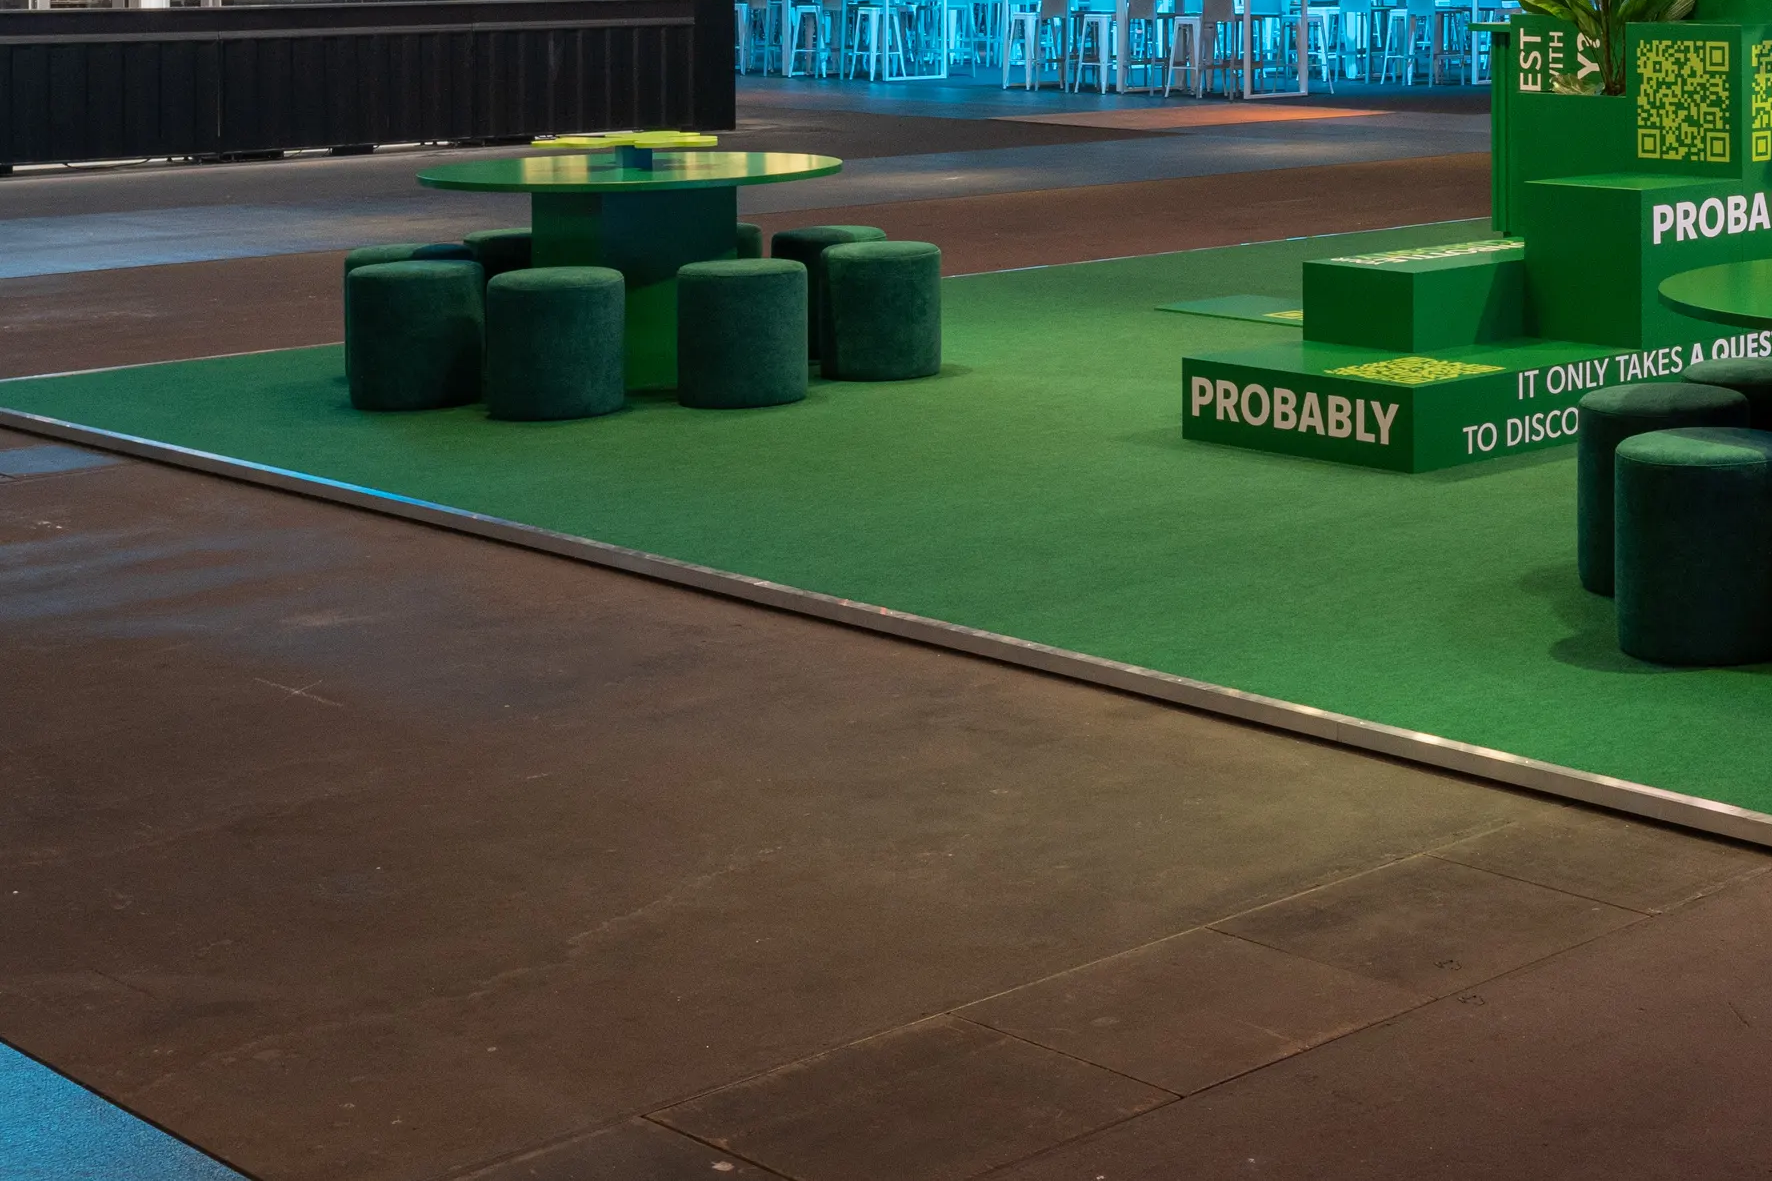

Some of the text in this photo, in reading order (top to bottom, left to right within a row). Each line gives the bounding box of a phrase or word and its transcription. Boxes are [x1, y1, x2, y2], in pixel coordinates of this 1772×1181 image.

[1518, 369, 1539, 400] IT
[1546, 358, 1610, 395] ONLY
[1615, 346, 1683, 382] TAKES
[1690, 342, 1705, 366] A
[1191, 375, 1400, 445] PROBABLY
[1462, 407, 1579, 455] TO DISCO
